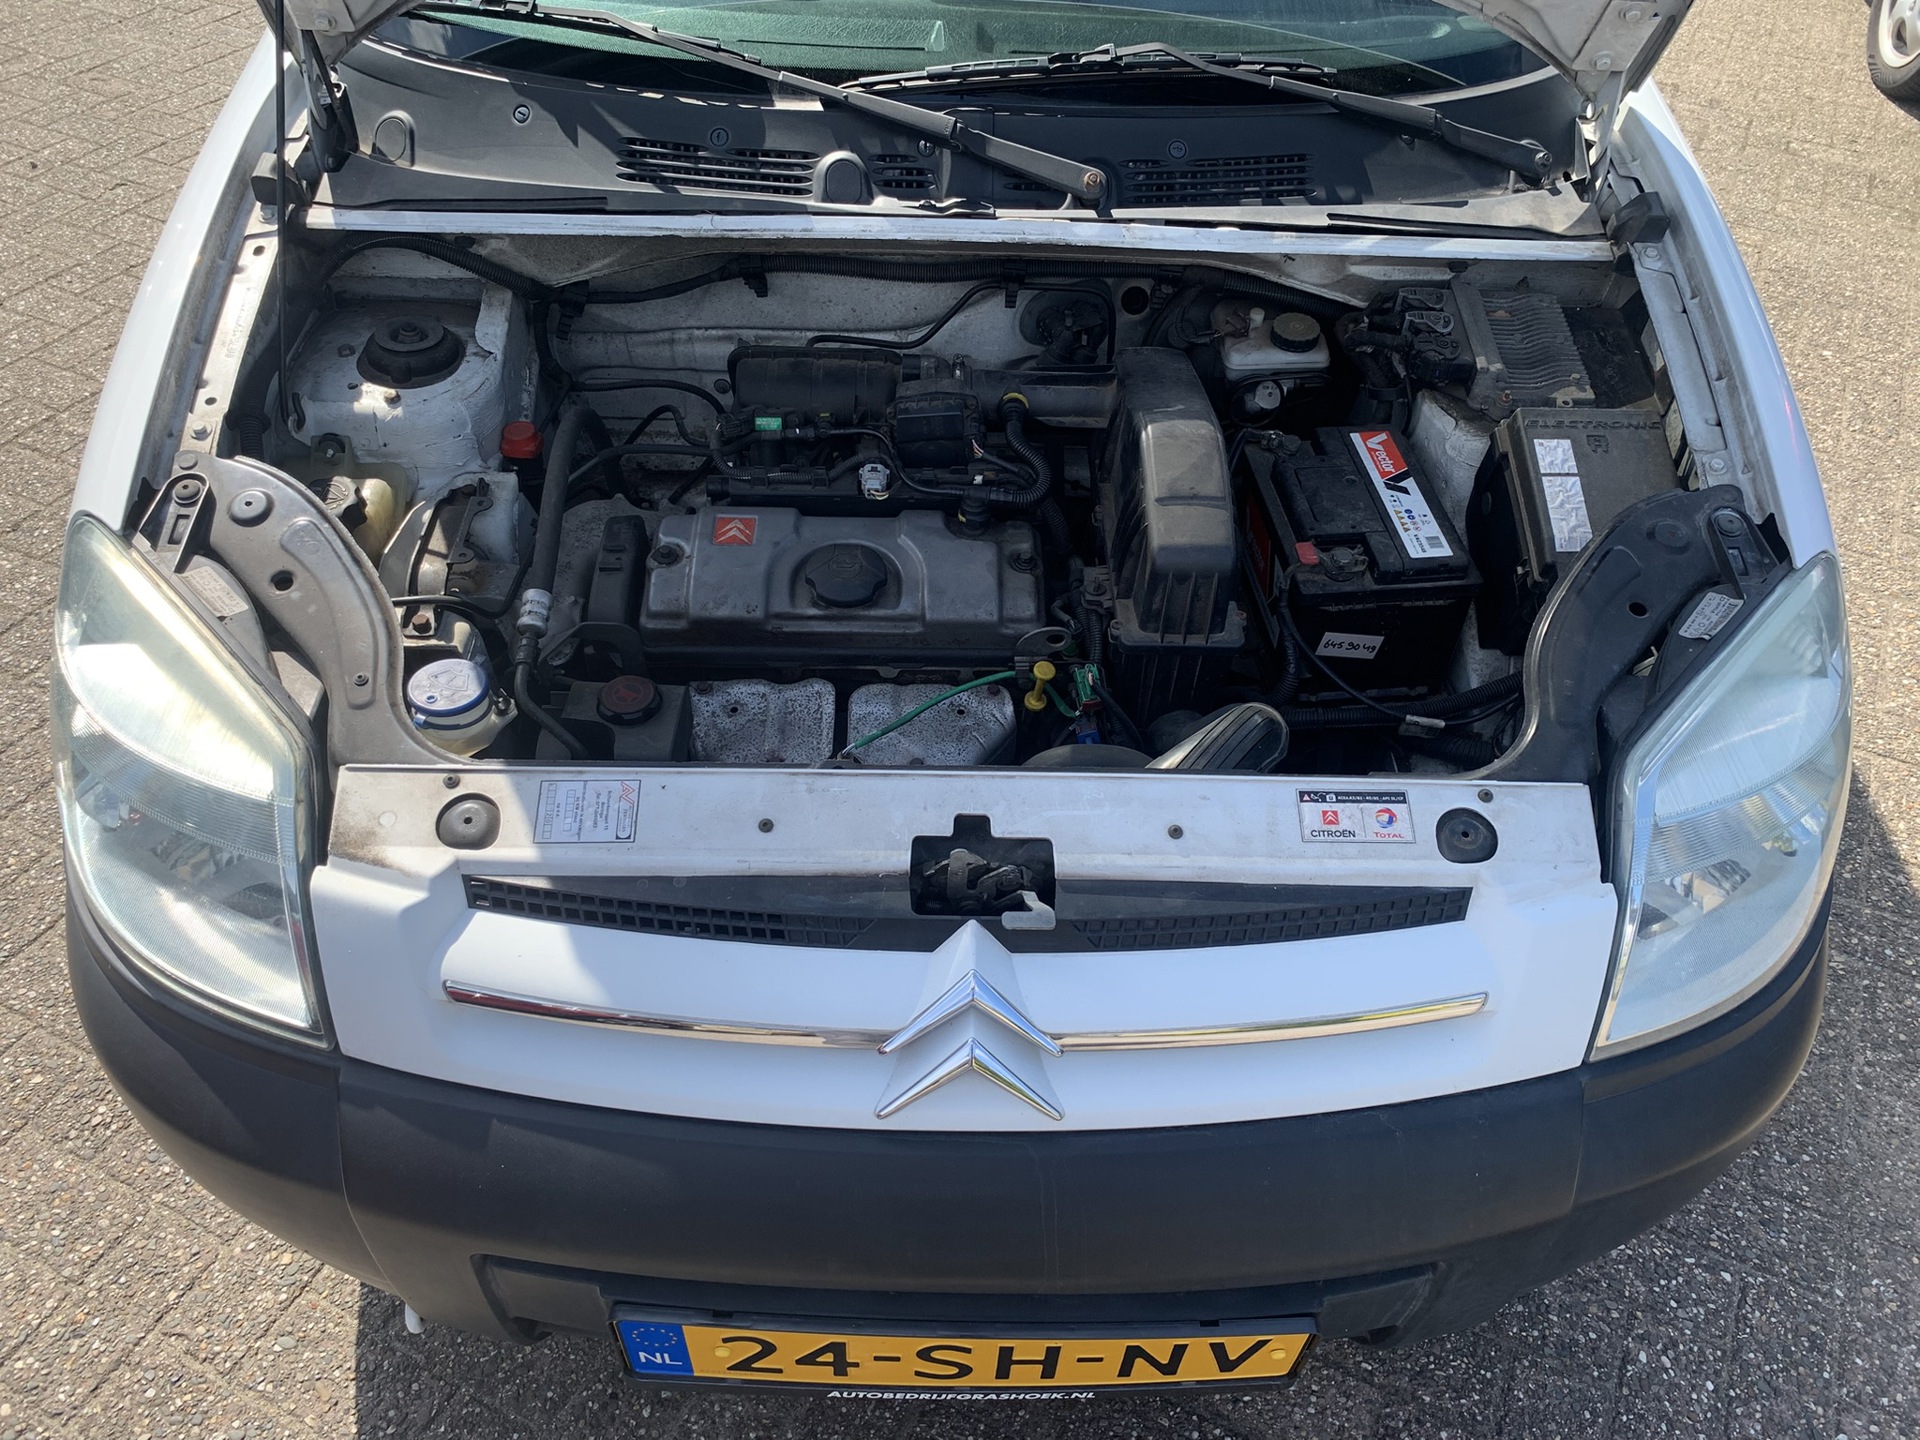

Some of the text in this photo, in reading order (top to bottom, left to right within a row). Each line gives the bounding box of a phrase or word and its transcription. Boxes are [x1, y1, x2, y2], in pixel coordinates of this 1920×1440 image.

[1525, 419, 1661, 431] ELECTRONIC
[1366, 432, 1395, 473] Vector
[1323, 639, 1345, 649] 645
[1345, 641, 1360, 651] 90
[1310, 829, 1356, 838] CITROËN
[638, 1351, 683, 1366] NL
[721, 1335, 1274, 1381] 24-SH-NV
[826, 1390, 1096, 1401] AUTOBEDRIJFGRASHOEK.NL
